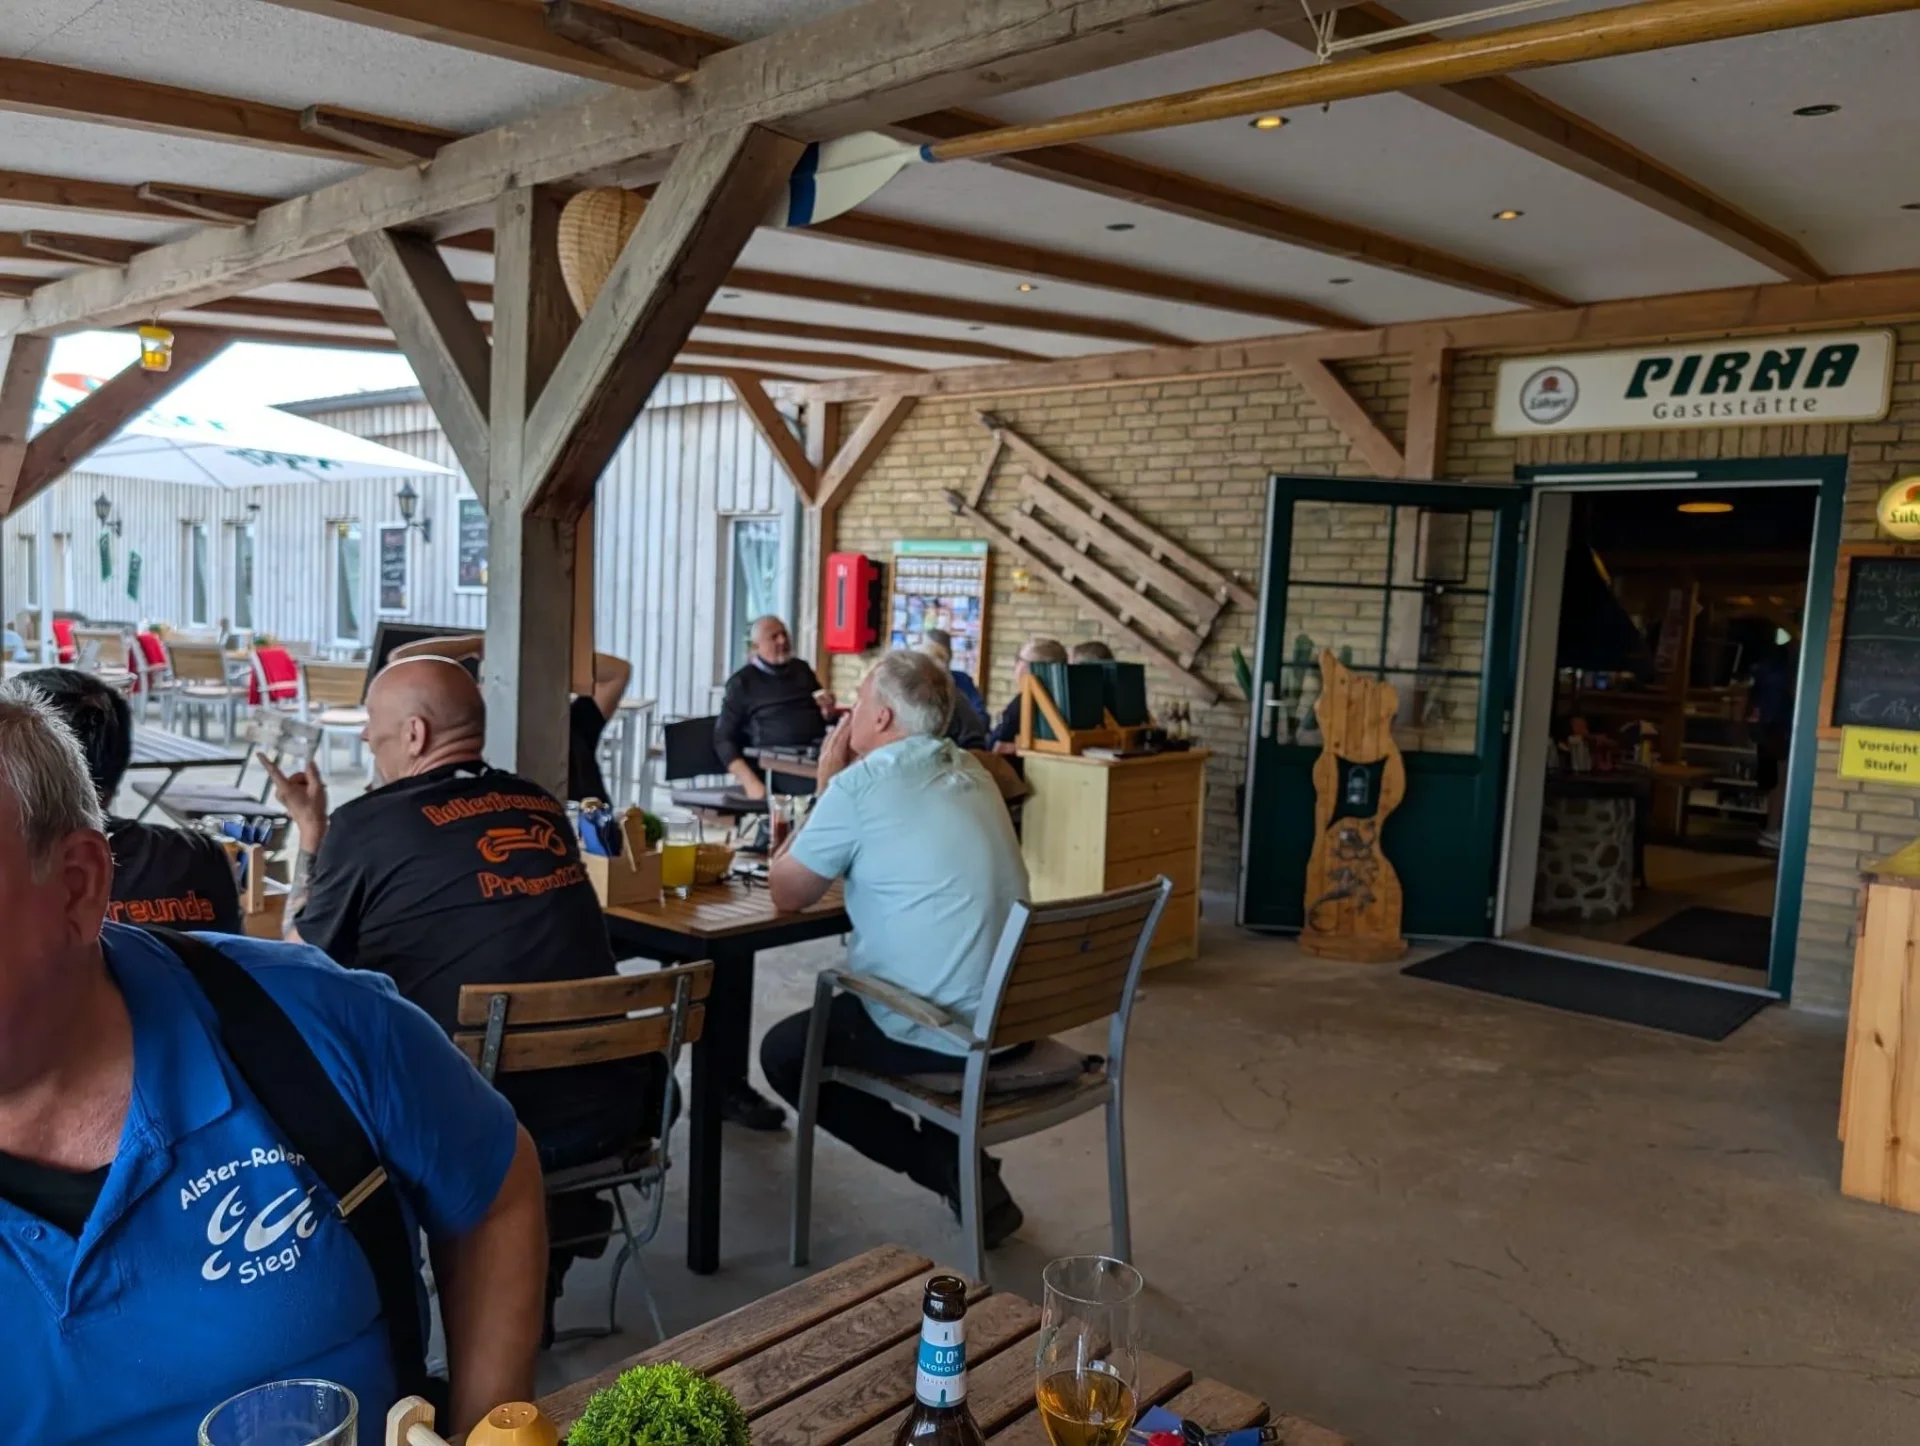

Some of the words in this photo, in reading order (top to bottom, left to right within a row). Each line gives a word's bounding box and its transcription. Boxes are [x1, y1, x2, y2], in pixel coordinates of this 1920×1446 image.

[1623, 342, 1861, 399] PIRNA
[1652, 397, 1818, 420] Gaststätte
[1858, 738, 1918, 756] Vorsicht
[238, 1239, 302, 1285] Siegi
